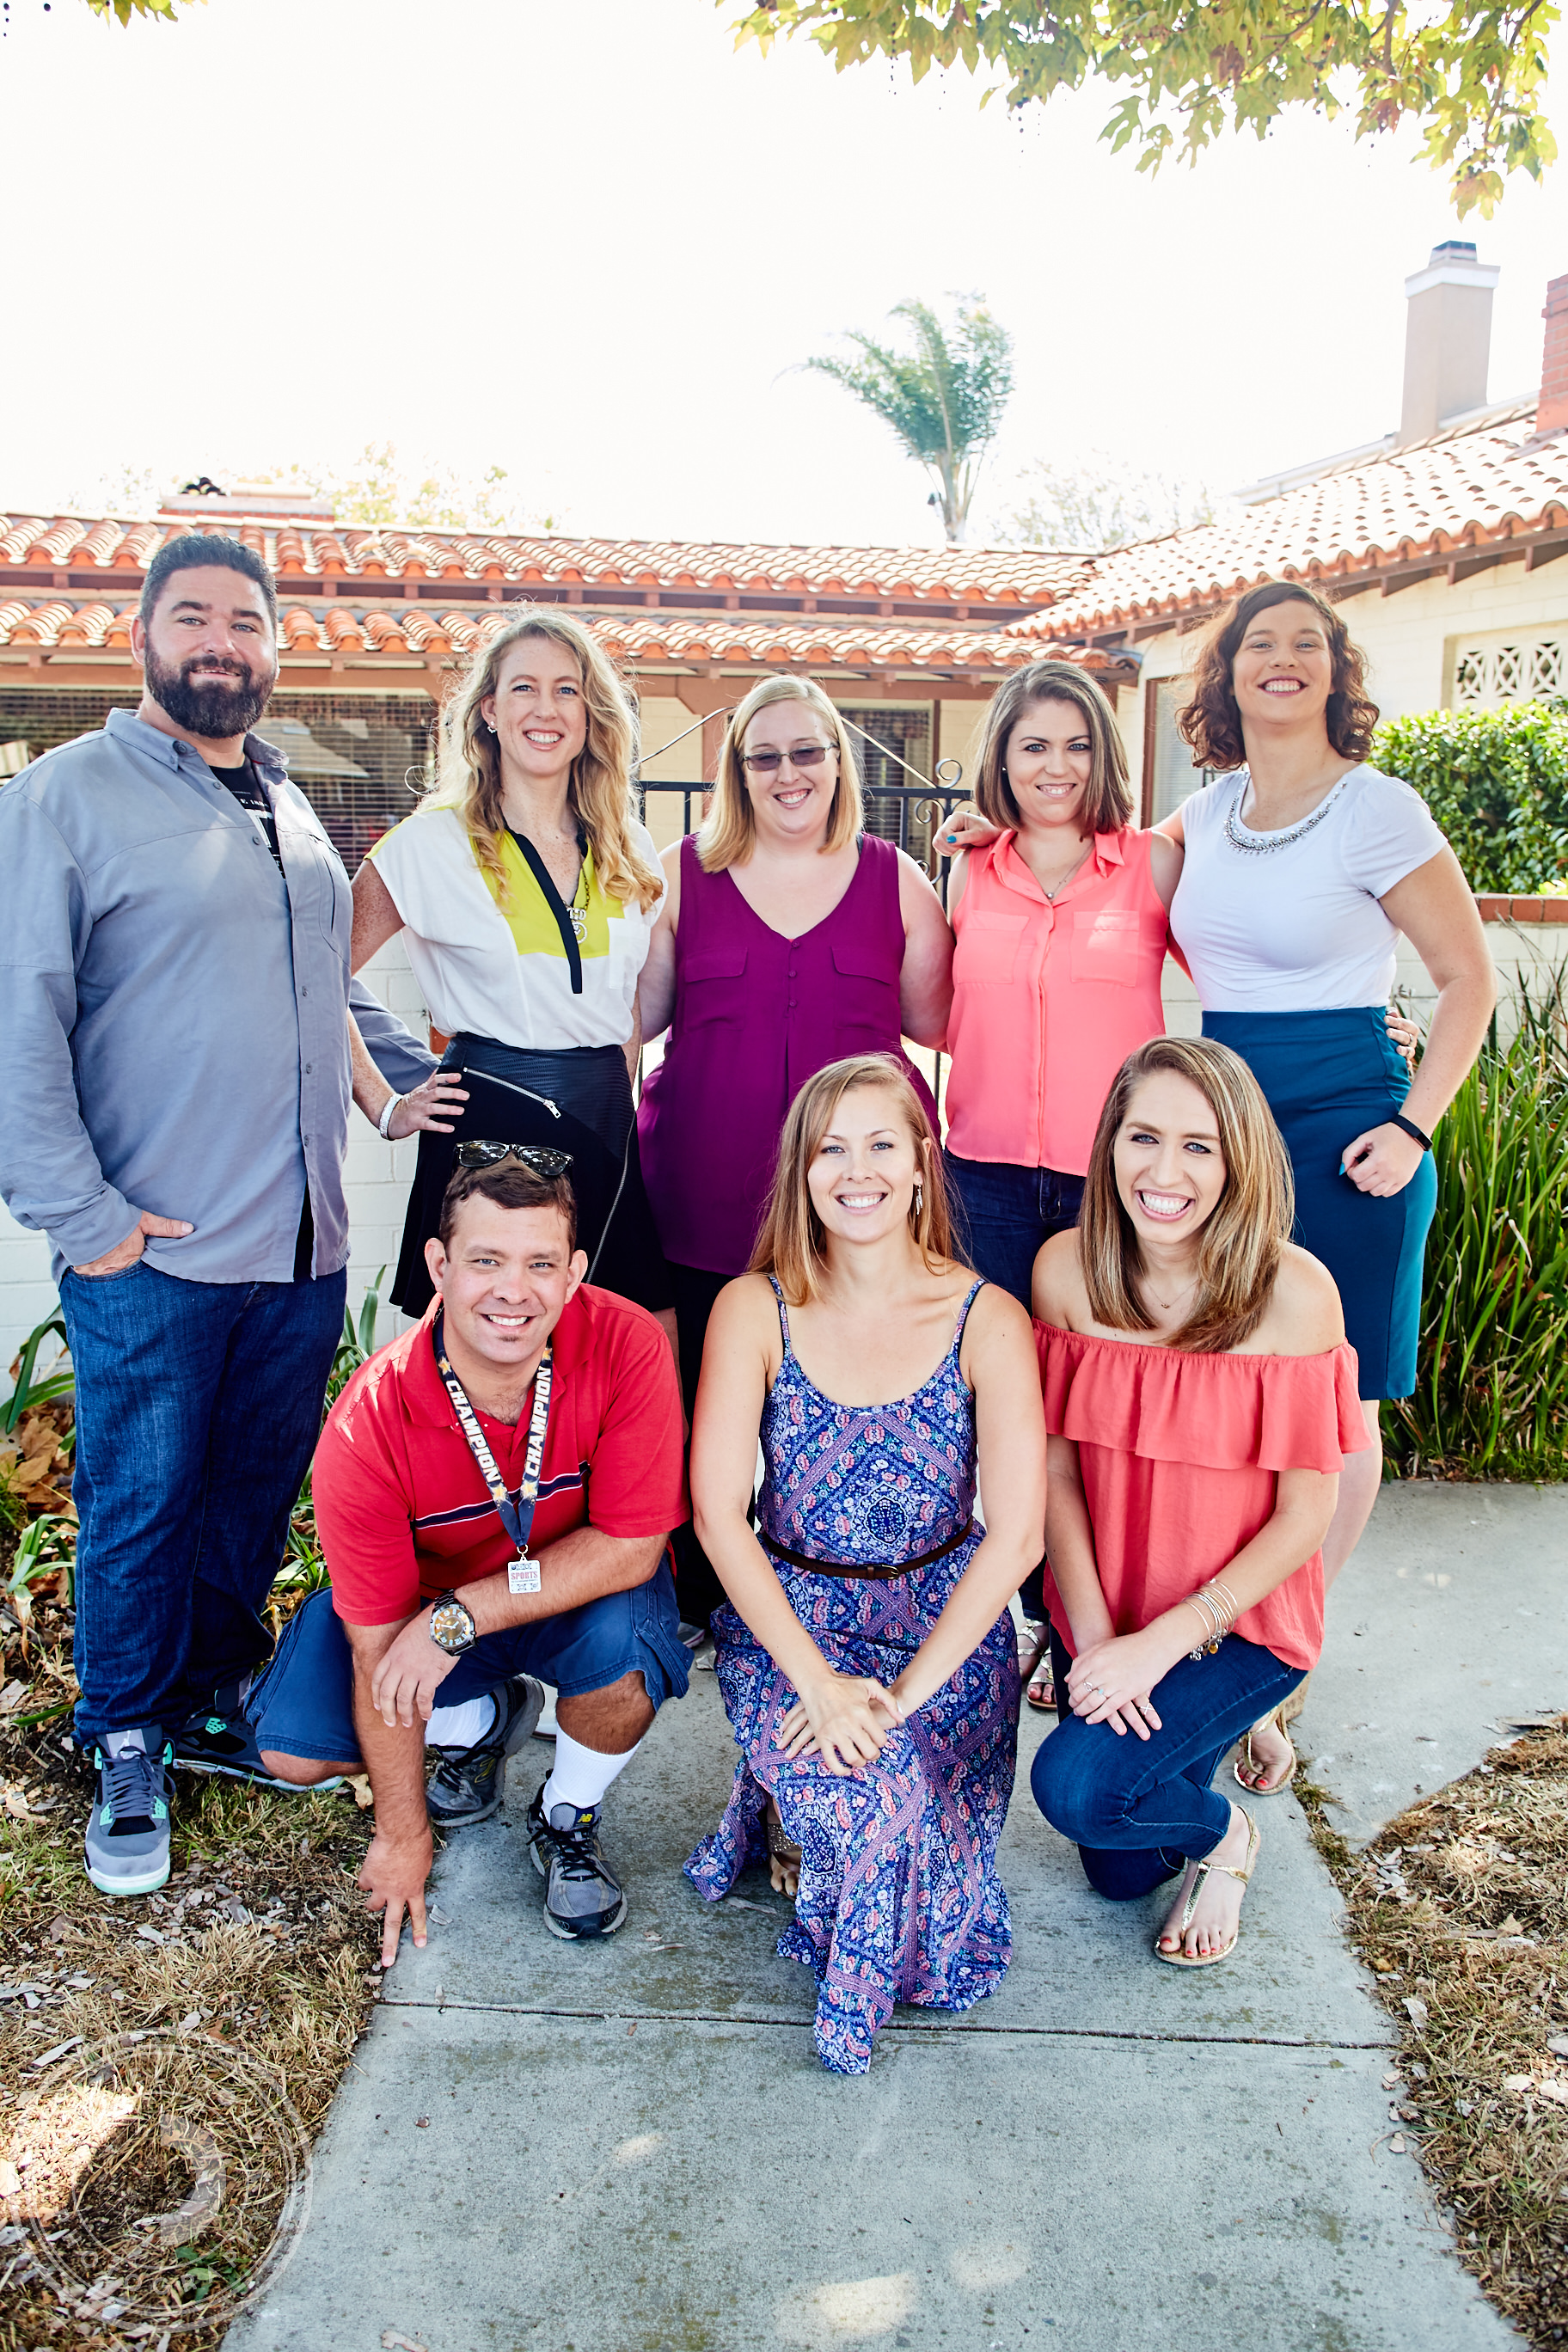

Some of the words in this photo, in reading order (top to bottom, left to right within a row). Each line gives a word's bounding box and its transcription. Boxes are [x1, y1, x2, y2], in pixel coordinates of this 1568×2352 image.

[445, 1379, 502, 1483] CHAMPION
[524, 1366, 552, 1478] CHAMPION
[511, 1571, 538, 1580] SPORTS
